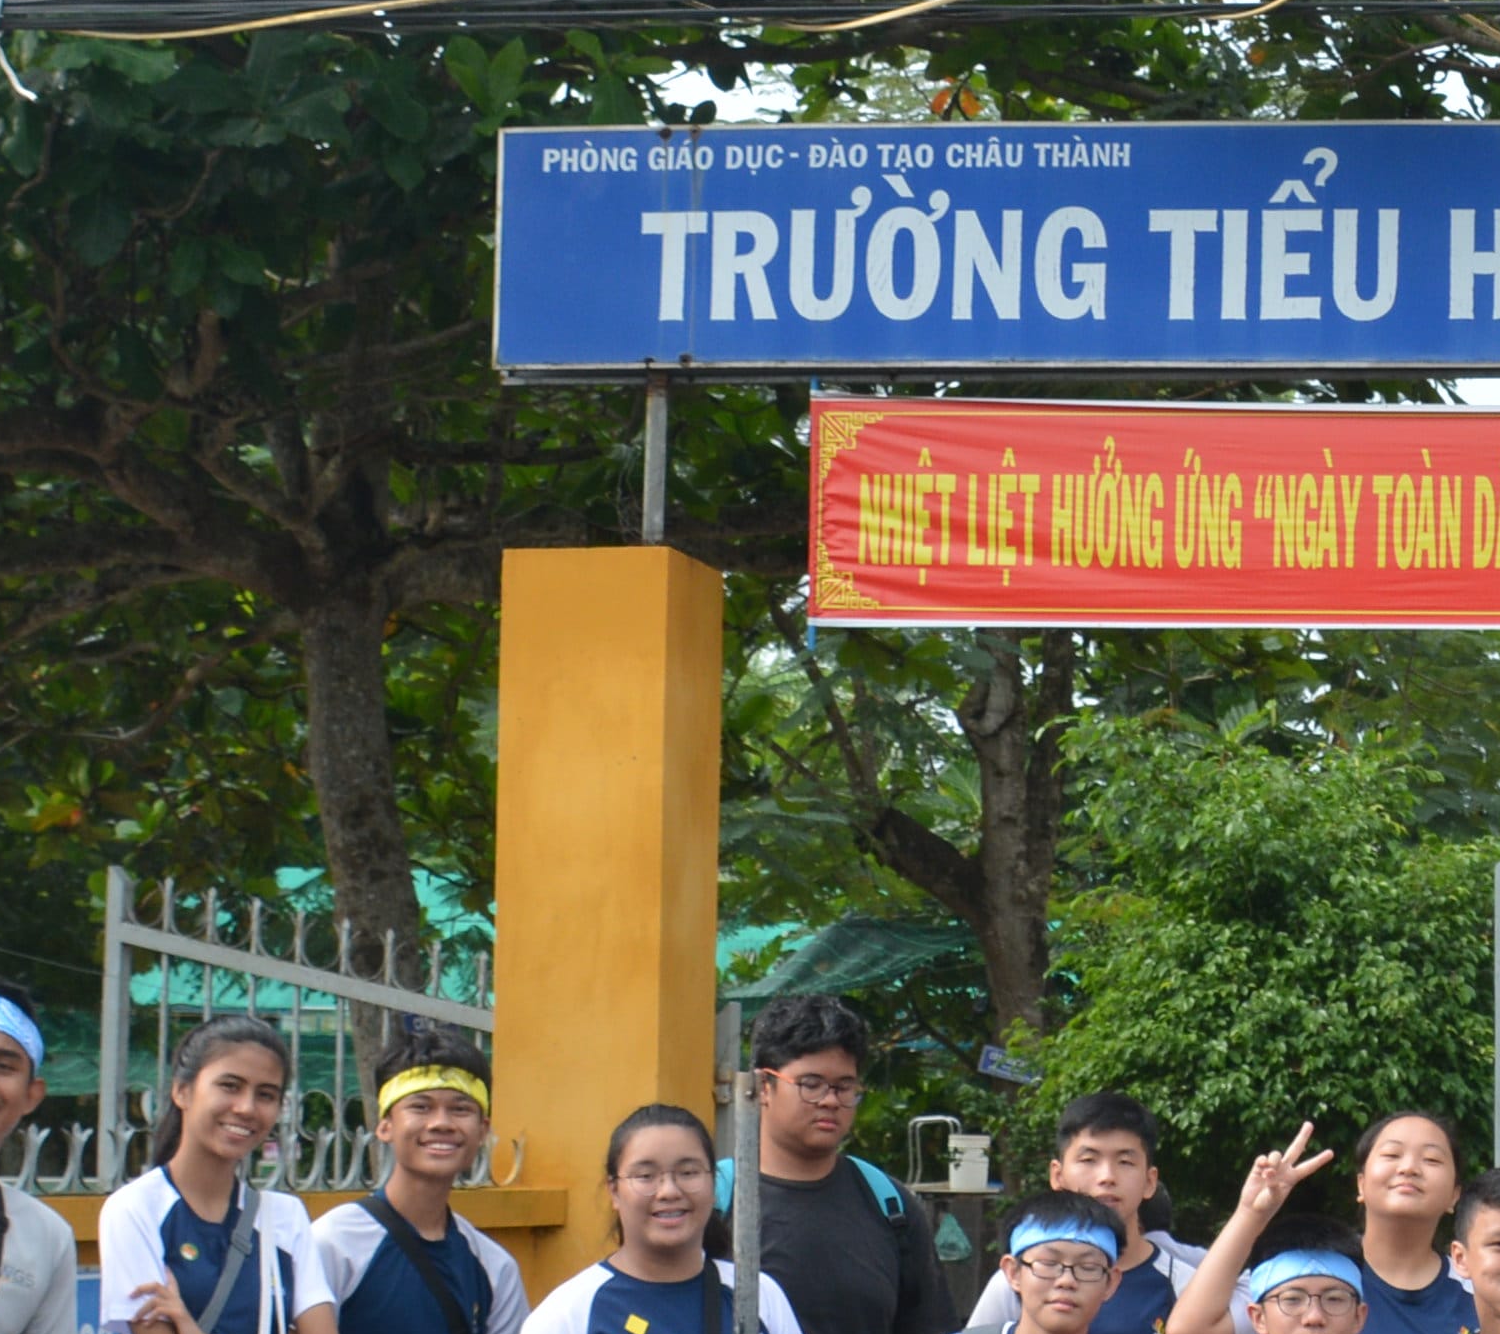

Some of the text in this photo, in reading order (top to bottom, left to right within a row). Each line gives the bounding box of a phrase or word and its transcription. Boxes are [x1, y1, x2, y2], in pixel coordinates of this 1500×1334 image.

[542, 140, 638, 173] PHÒNG
[647, 139, 714, 171] GIÁO
[808, 137, 868, 168] ĐÀO
[877, 143, 934, 174] TẠO
[945, 136, 1024, 168] CHÂU
[1033, 135, 1131, 167] THÀNH
[641, 175, 1108, 321] TRƯỜNG
[1149, 147, 1400, 321] TIỂU
[858, 447, 957, 586] NHIỆT
[967, 447, 1040, 587] LIỆT
[1051, 435, 1164, 570] HƯỞNG
[1175, 448, 1243, 570] ỨNG
[1372, 448, 1462, 570] TOÀN
